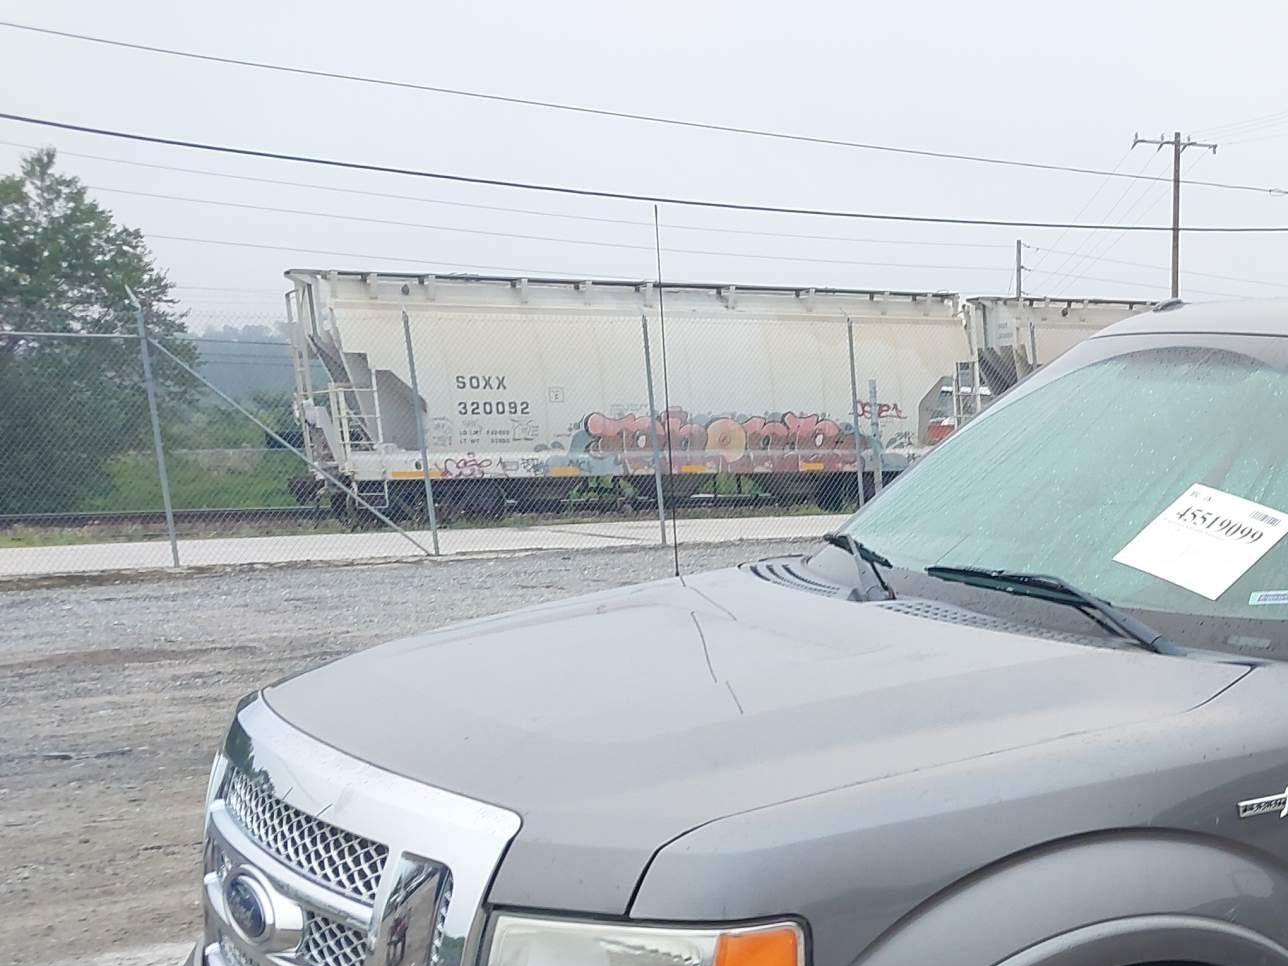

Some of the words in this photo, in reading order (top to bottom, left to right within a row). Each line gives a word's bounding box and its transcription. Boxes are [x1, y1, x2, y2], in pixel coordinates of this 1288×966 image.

[455, 375, 507, 391] SOXX
[457, 401, 530, 416] 320092
[1176, 506, 1264, 544] 45519099
